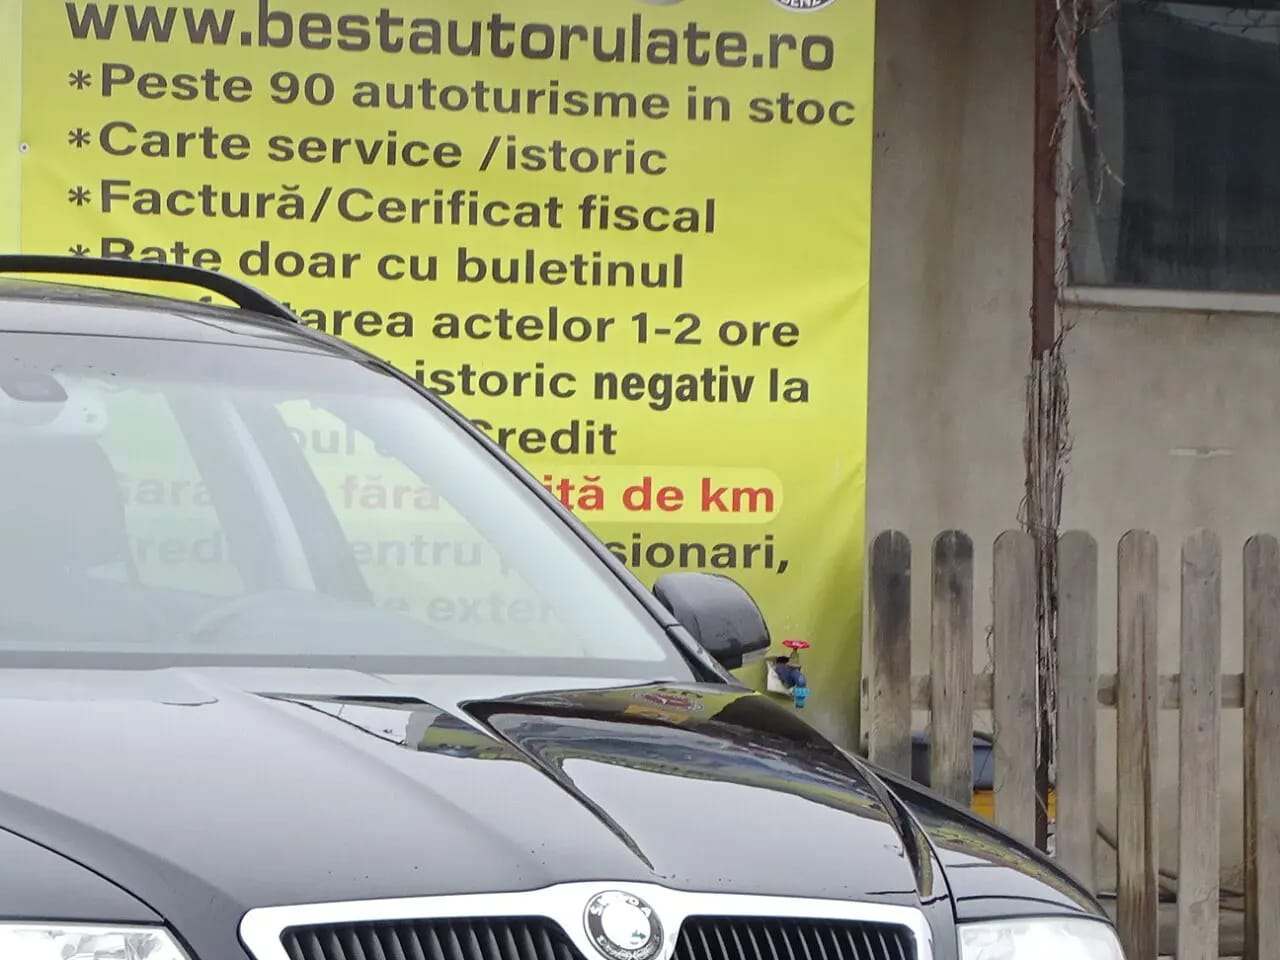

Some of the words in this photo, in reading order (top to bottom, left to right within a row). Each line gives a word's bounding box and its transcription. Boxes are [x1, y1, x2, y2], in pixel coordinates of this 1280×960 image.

[64, 0, 835, 72] www.bestautorulate.ro
[101, 62, 253, 103] Peste
[269, 71, 335, 106] 90
[352, 78, 670, 120] autoturisme
[687, 85, 731, 122] in
[748, 91, 855, 127] stoc
[99, 121, 251, 160] Carte
[267, 130, 462, 169] service
[578, 193, 715, 234] fiscal
[238, 240, 361, 279] doar
[377, 254, 438, 282] cu
[457, 247, 683, 289] buletinul
[431, 306, 615, 343] actelor
[631, 311, 702, 345] 1-2
[718, 320, 800, 348] ore
[415, 359, 577, 398] istoric
[594, 365, 755, 412] negativ
[769, 367, 809, 403] la
[622, 476, 684, 512] de
[701, 477, 774, 513] km
